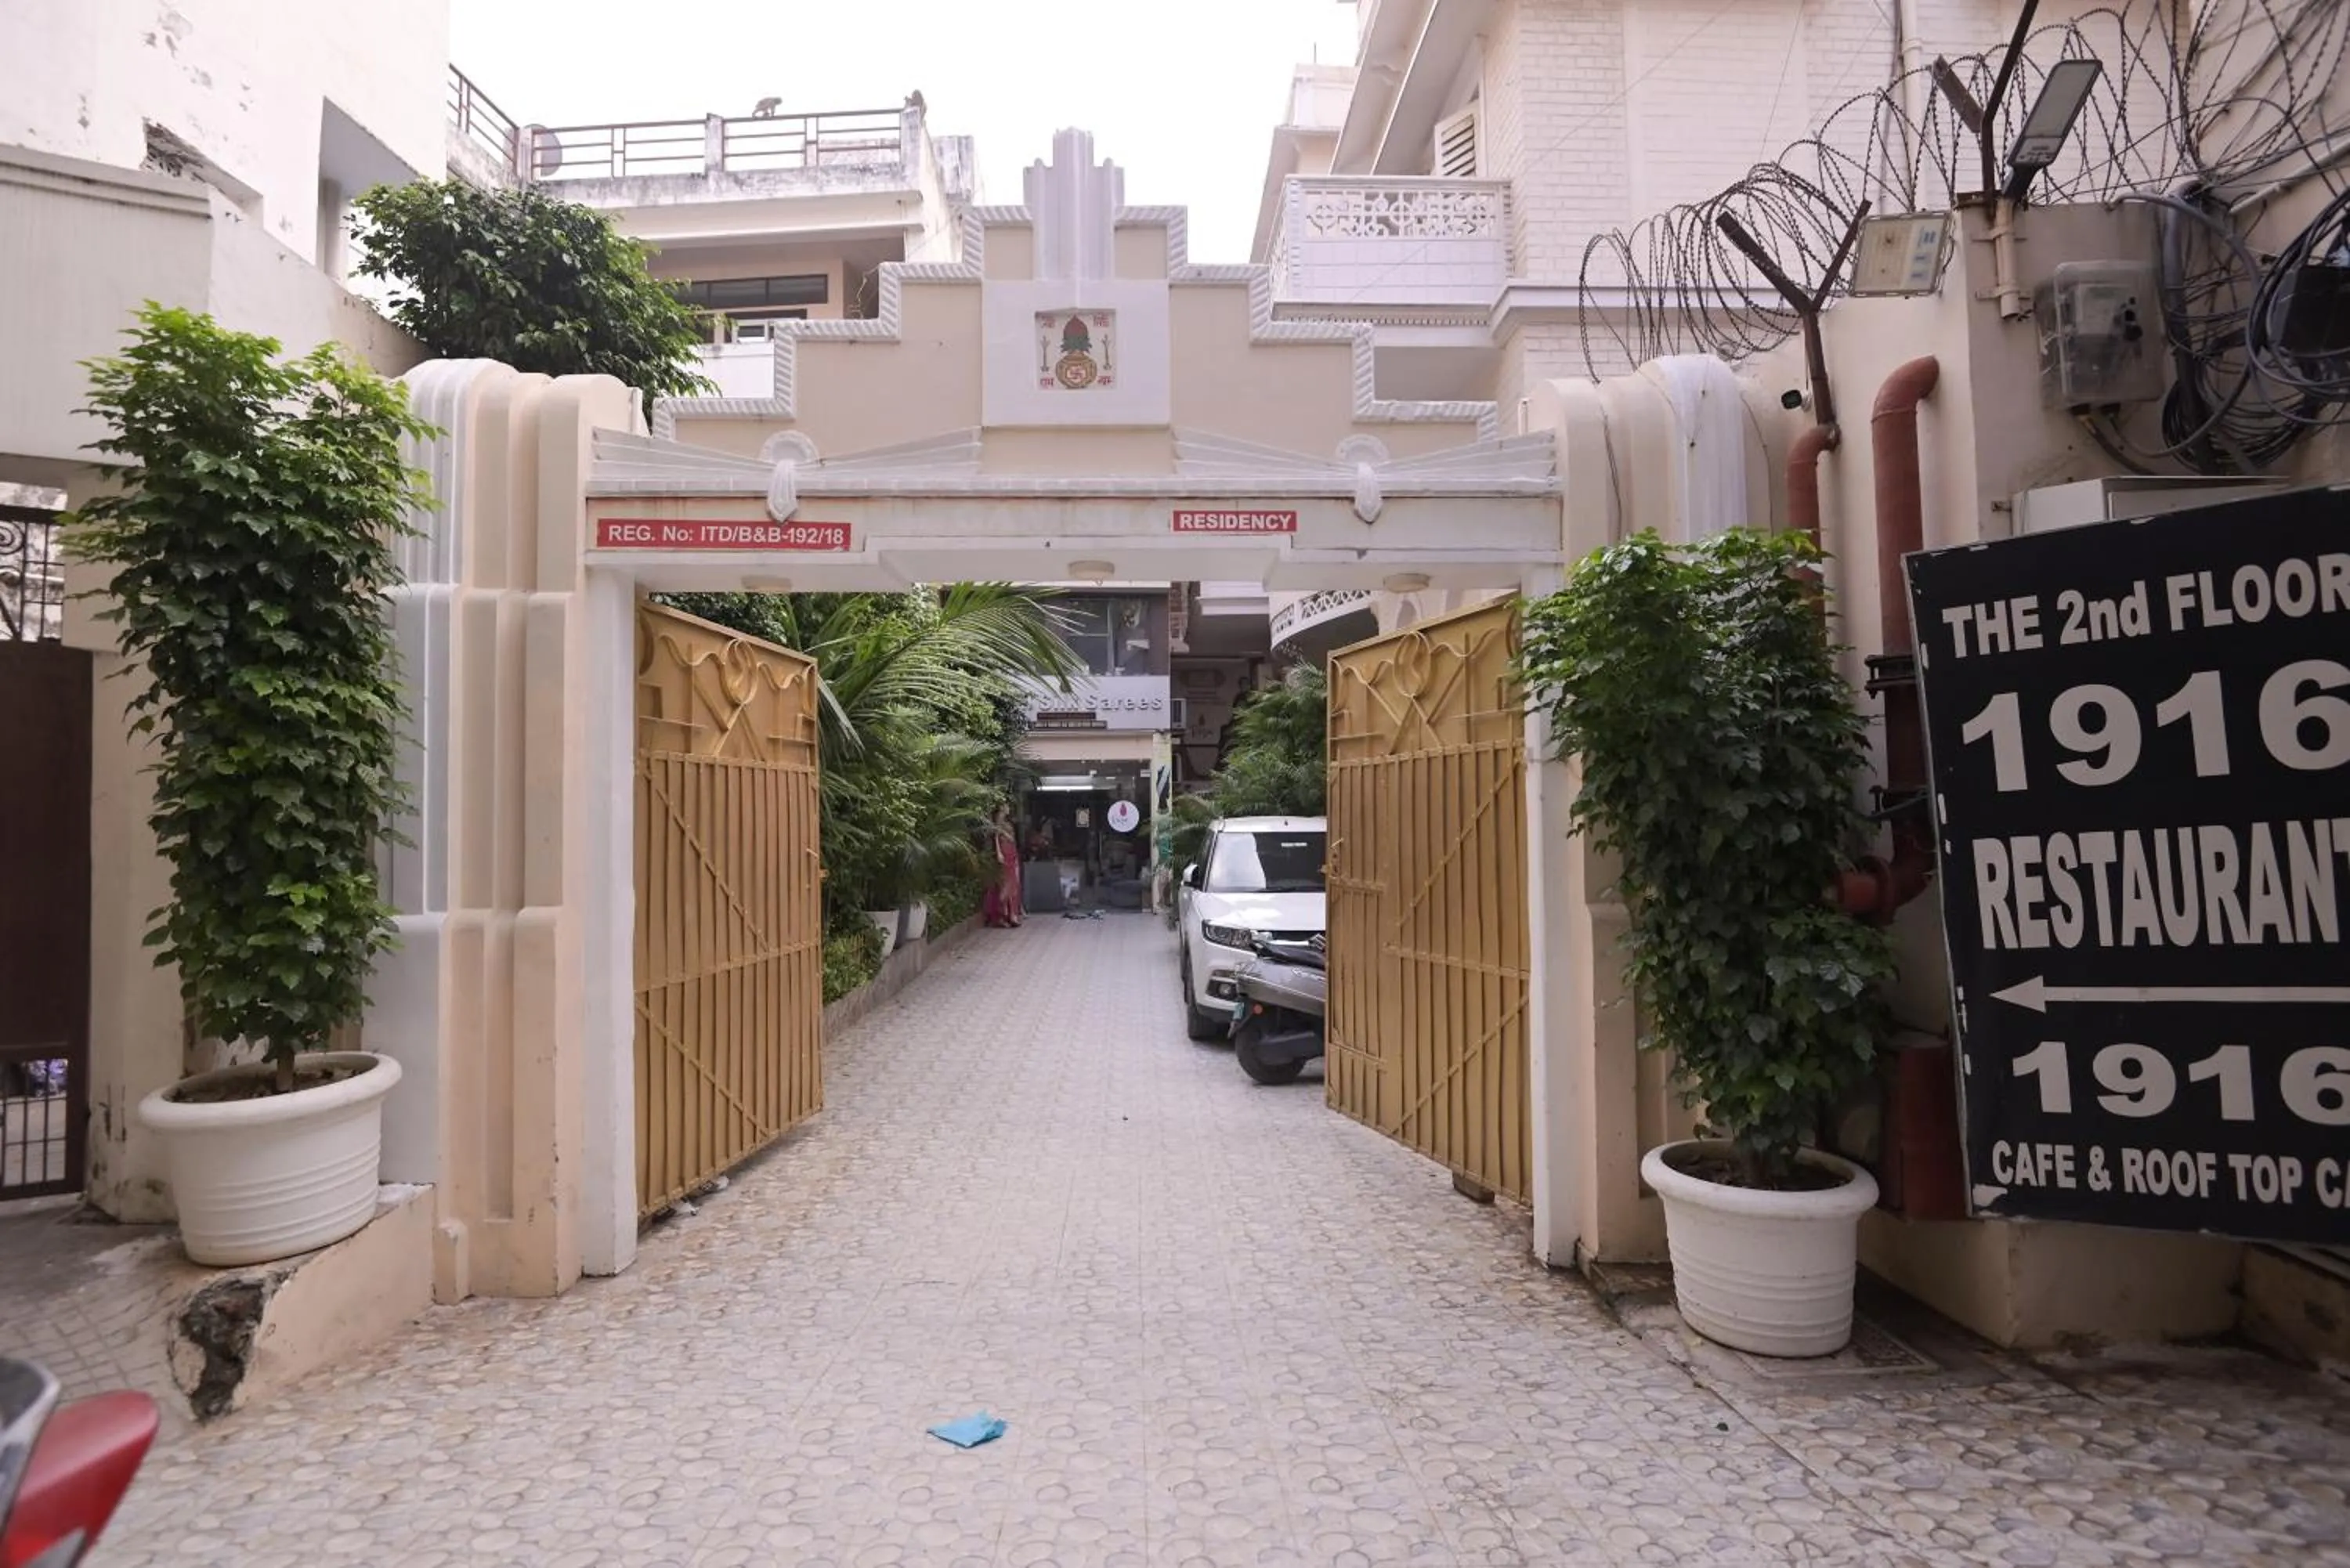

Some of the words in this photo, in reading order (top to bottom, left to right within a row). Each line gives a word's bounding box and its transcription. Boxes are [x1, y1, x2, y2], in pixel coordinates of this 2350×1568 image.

[609, 526, 655, 541] REG.
[662, 526, 693, 542] No:
[701, 526, 844, 544] ITD/B&B-192/18
[1180, 514, 1292, 529] RESIDENCY
[1942, 595, 2044, 659] THE
[2056, 580, 2151, 645] 2nd
[2166, 553, 2350, 632] FLOOR
[1086, 694, 1163, 711] Sarees
[1962, 659, 2350, 792] 1916
[2012, 1042, 2350, 1125] 1916
[1992, 1140, 2077, 1189] CAFE
[2088, 1146, 2112, 1191] &
[2121, 1147, 2217, 1198] ROOF
[2227, 1154, 2302, 1204] TOP
